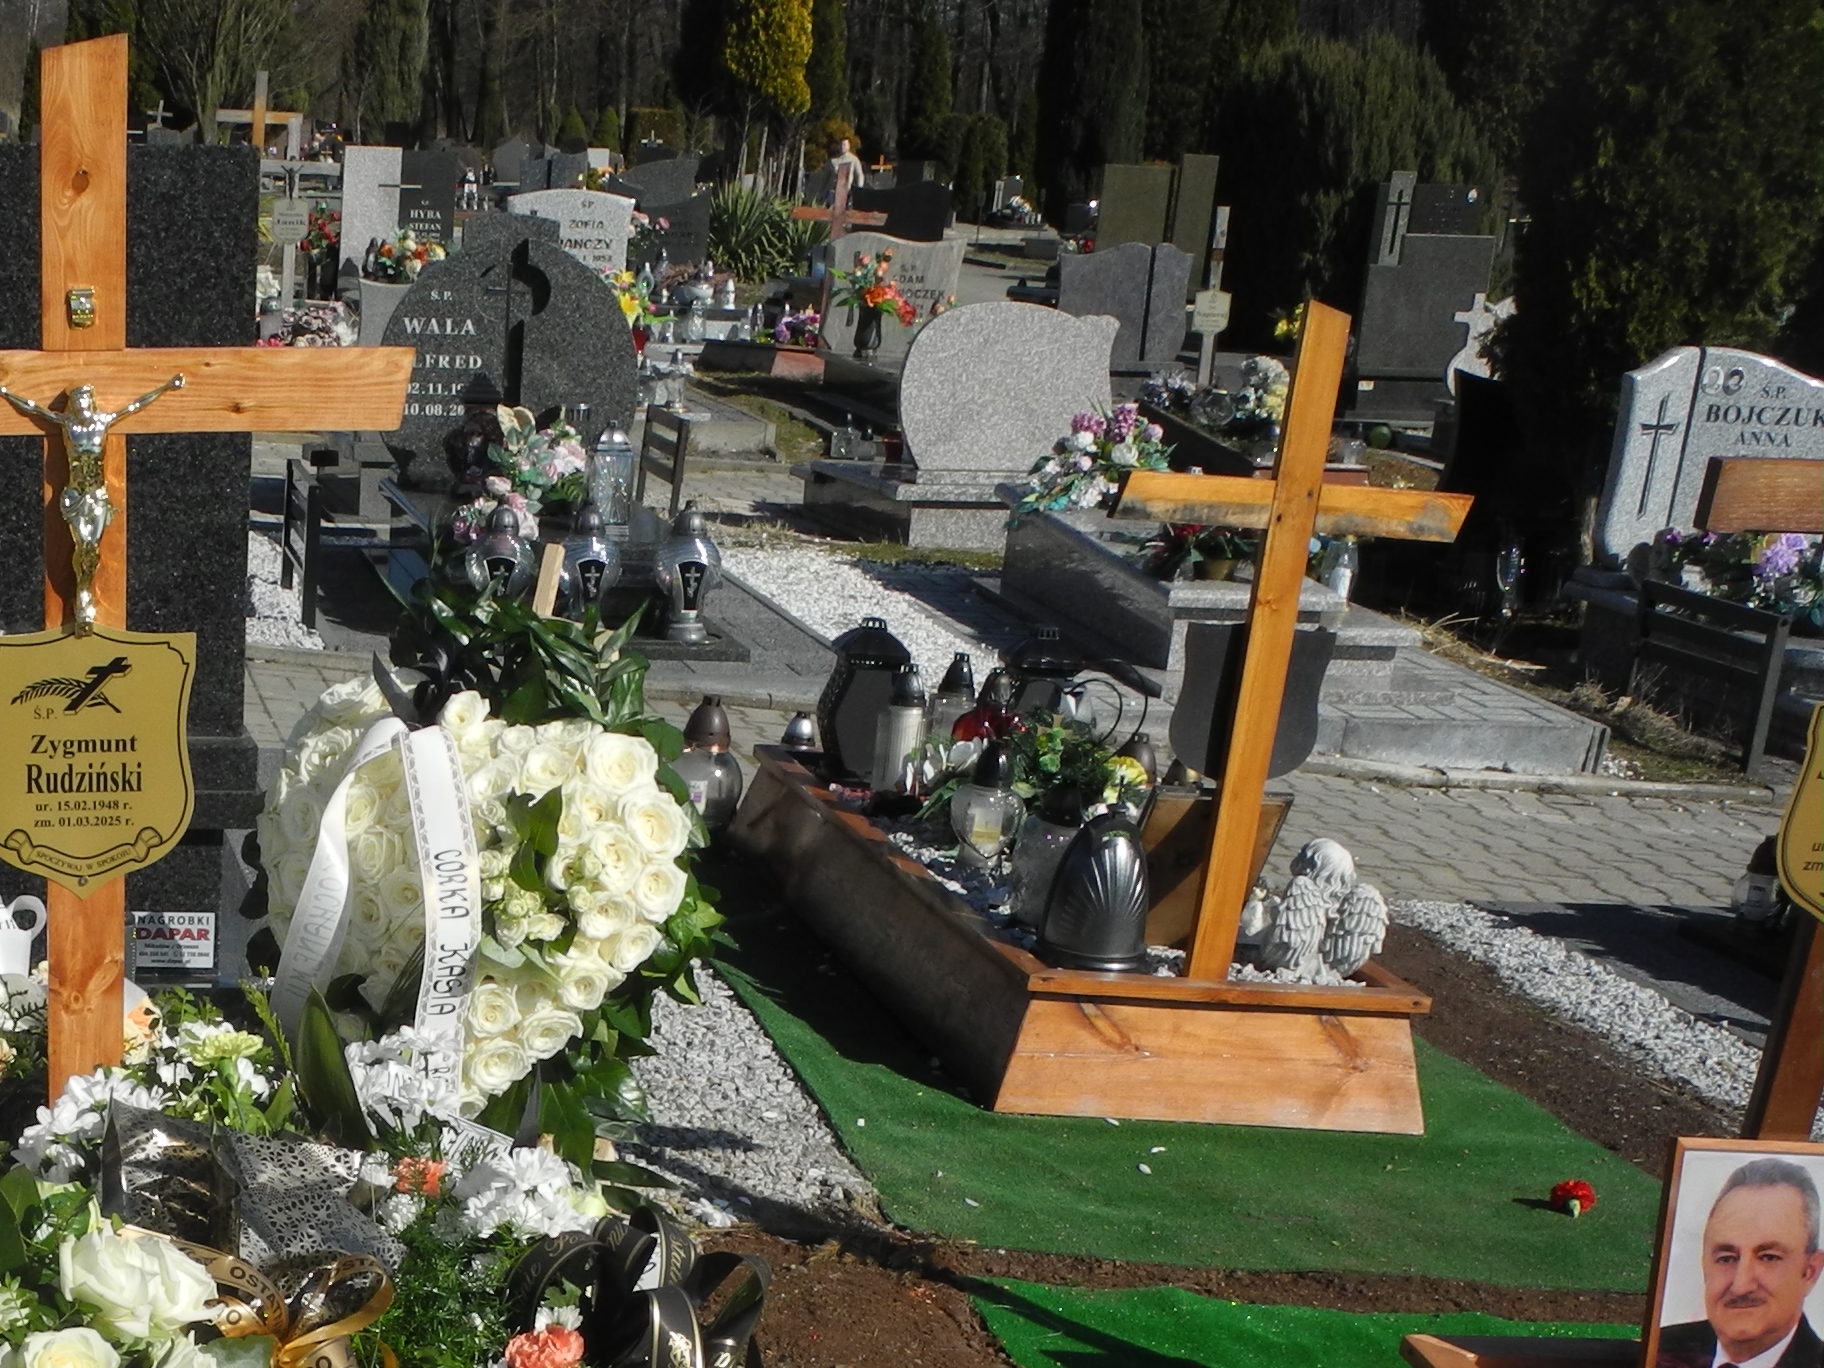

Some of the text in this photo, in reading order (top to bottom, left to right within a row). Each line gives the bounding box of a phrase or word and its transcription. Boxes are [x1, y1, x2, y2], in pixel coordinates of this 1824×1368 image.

[409, 209, 442, 220] HYBA
[568, 218, 604, 229] ZOFIA
[403, 317, 477, 336] WALA
[413, 353, 483, 369] LFRED
[1734, 431, 1792, 447] ANNA
[30, 733, 139, 759] Zygmunt
[25, 761, 143, 794] Rudziński
[35, 800, 133, 812] ur. 15.02.1948 r.
[33, 816, 135, 828] zm. 01.03.2025 r.
[36, 850, 83, 872] SPOCZYWAJ
[96, 848, 132, 867] SPOKOJU
[137, 915, 210, 926] NAGROBKI
[136, 927, 211, 940] DAPAR
[428, 943, 471, 1017] KASIA
